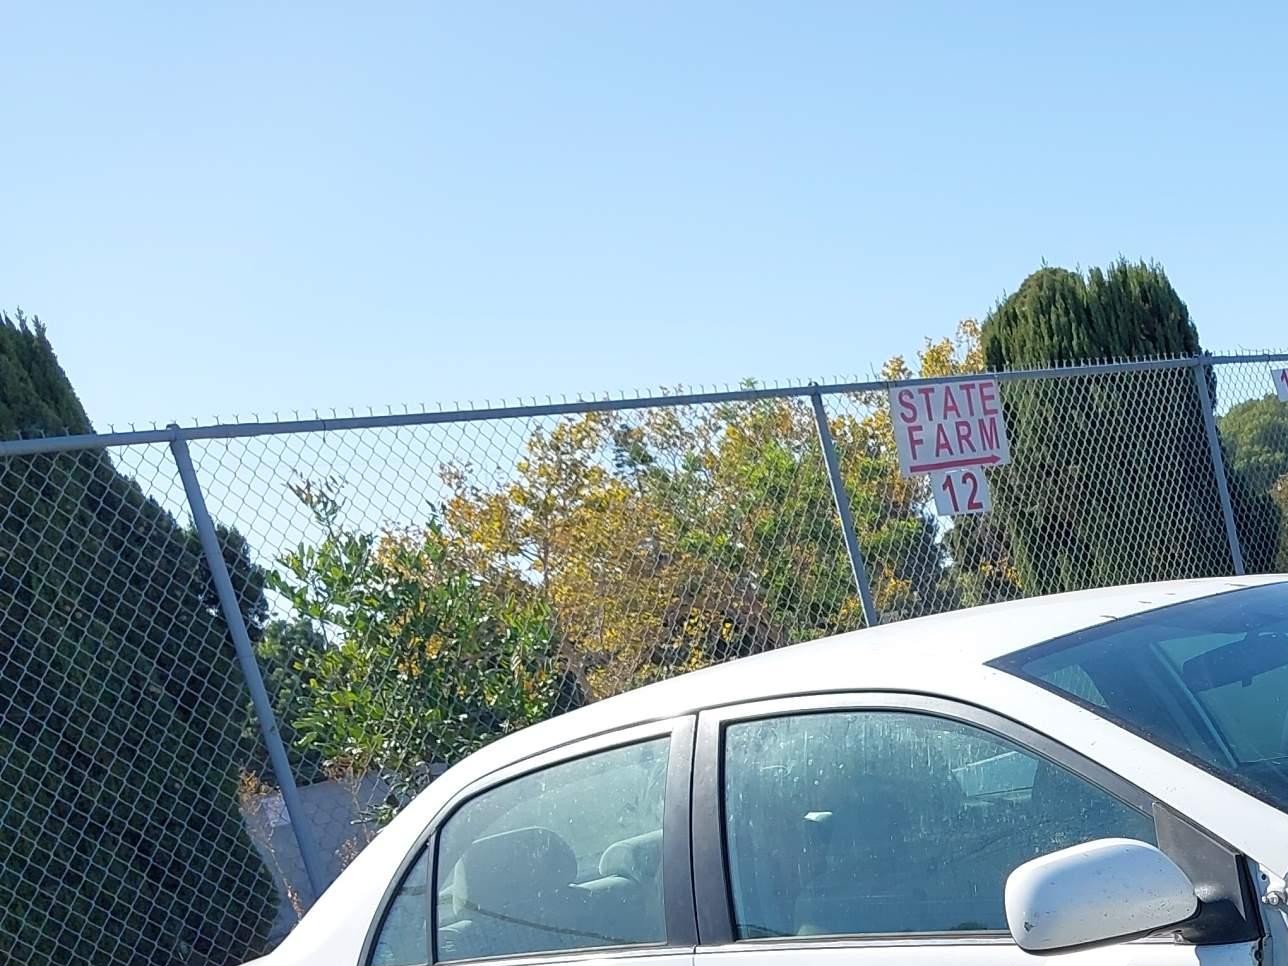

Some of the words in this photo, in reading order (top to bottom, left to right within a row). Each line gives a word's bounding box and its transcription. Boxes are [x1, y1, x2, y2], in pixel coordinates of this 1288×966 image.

[898, 382, 998, 424] STATE
[907, 417, 1000, 460] FARM
[942, 472, 984, 512] 12
